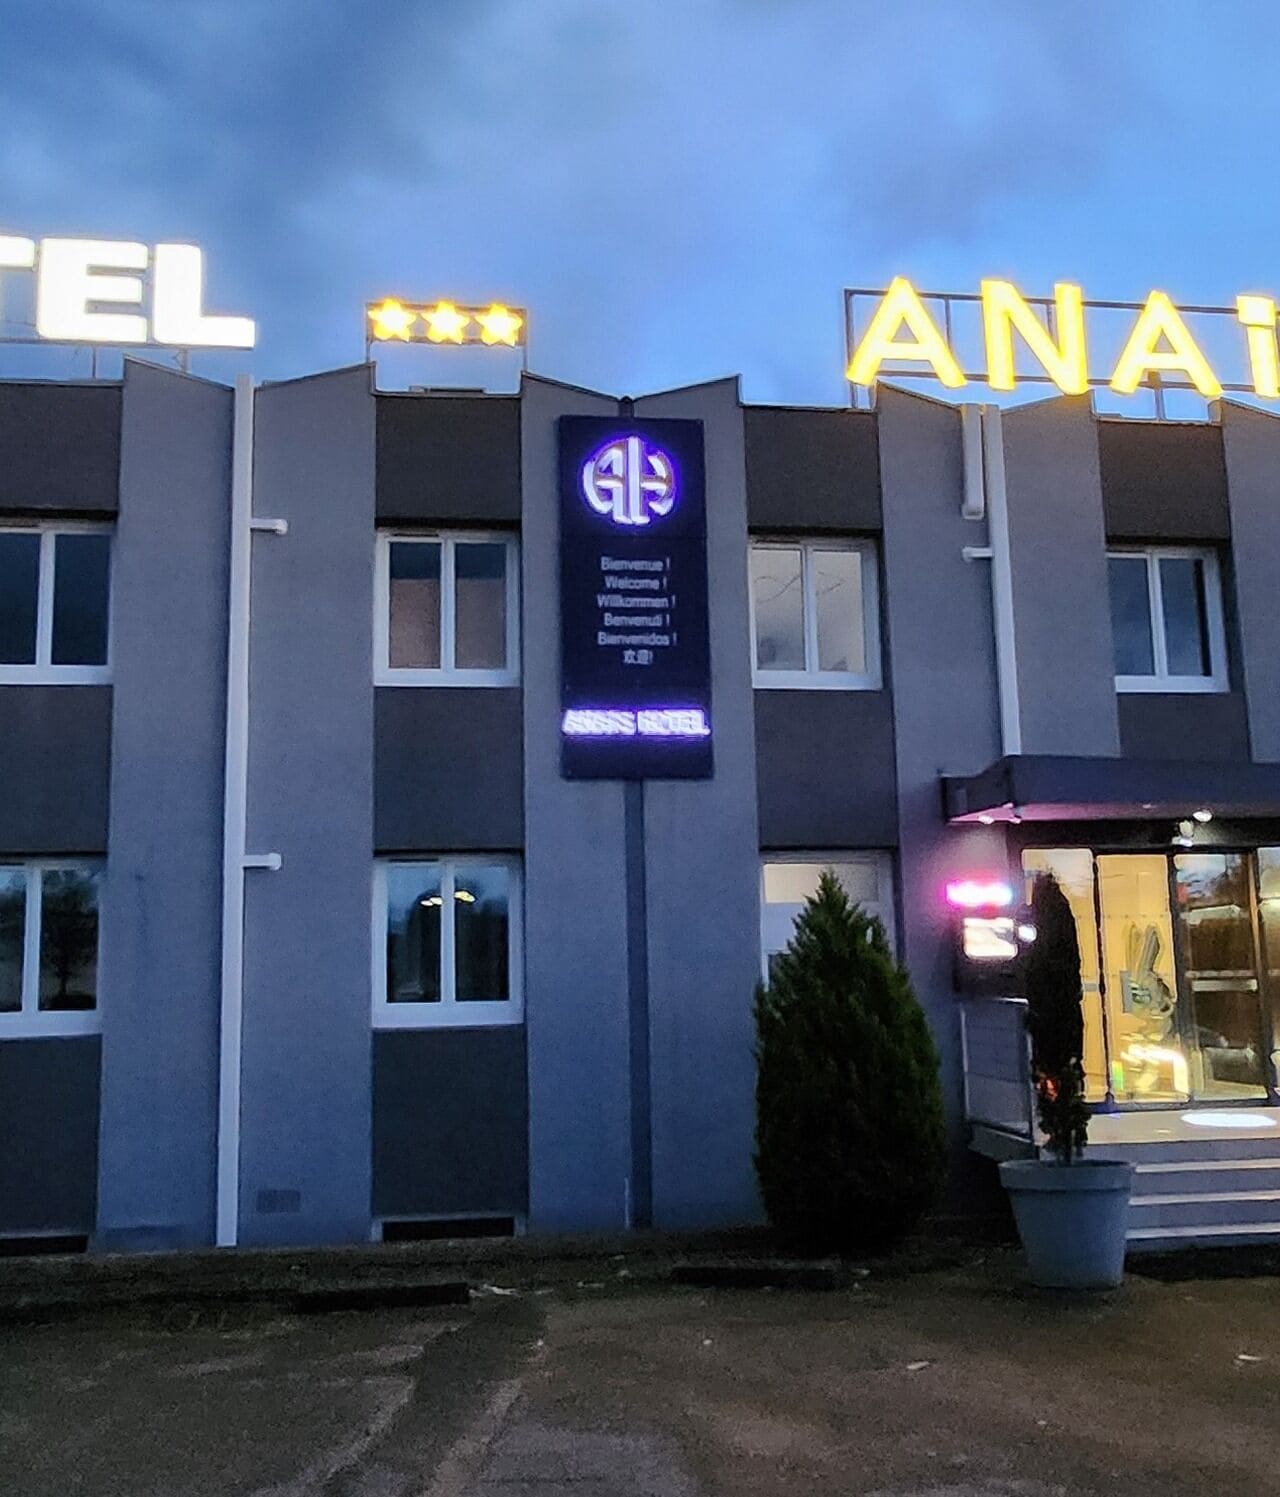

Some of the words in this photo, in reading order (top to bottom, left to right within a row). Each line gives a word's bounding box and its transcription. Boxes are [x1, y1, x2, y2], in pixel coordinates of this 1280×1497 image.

[601, 556, 663, 571] Bienvenue
[604, 576, 660, 590] Welcome
[597, 594, 669, 608] Willkommen
[598, 631, 670, 645] Bienvenidos
